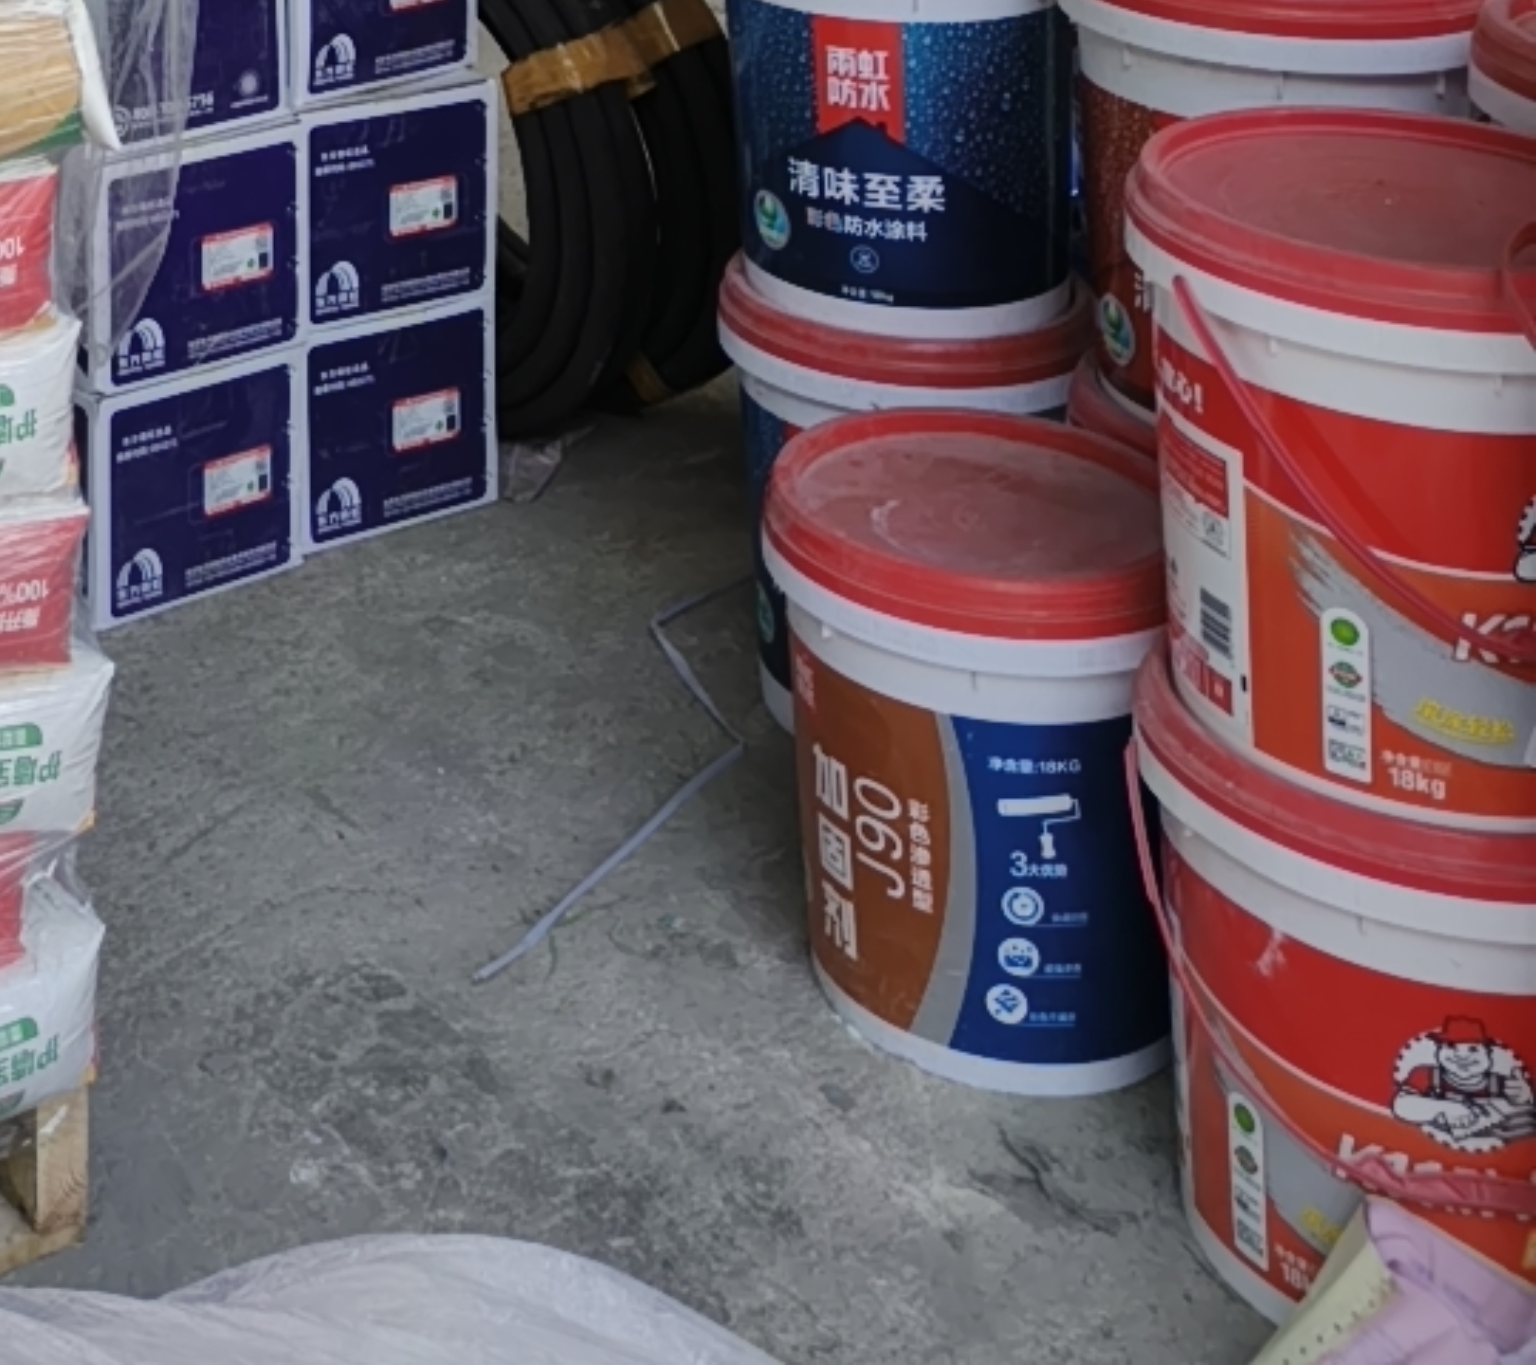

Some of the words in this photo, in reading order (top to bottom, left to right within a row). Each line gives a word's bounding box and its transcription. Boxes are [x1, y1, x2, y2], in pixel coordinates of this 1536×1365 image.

[825, 46, 888, 80] 雨虹
[827, 77, 890, 111] 防水
[789, 157, 945, 212] 清味至柔
[1388, 766, 1446, 800] 18kg
